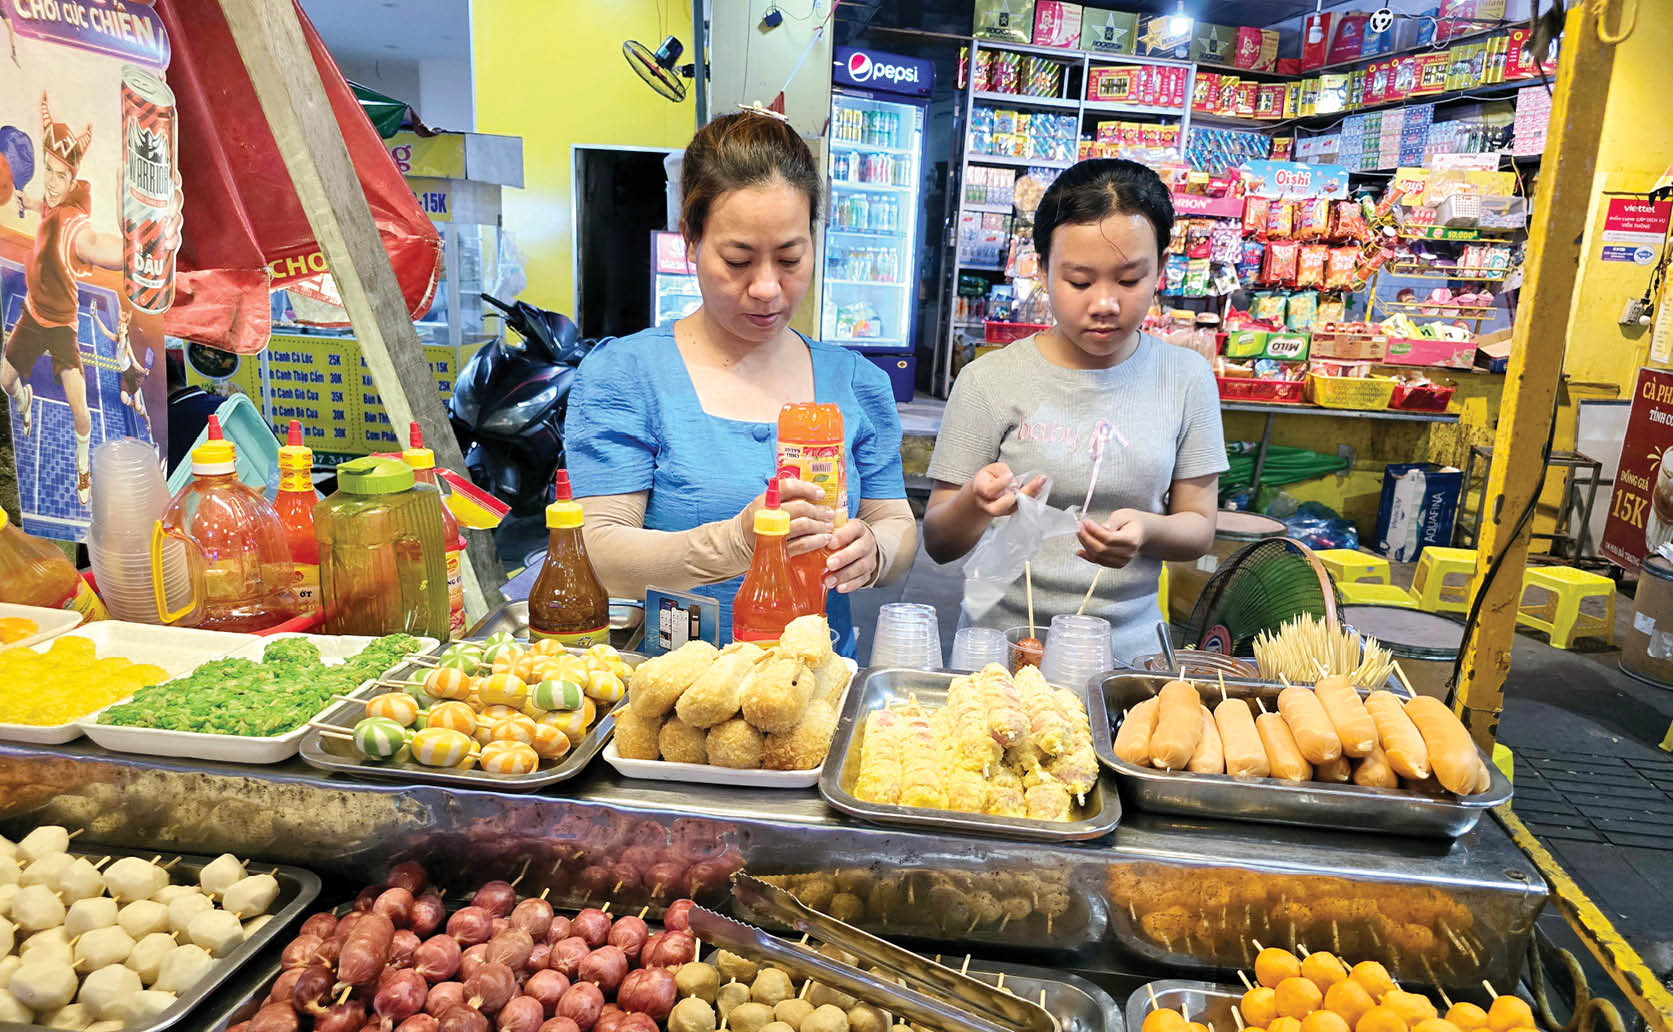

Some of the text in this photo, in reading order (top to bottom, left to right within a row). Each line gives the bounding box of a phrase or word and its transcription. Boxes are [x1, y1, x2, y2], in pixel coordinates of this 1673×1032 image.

[873, 61, 920, 83] pepsi
[1275, 169, 1311, 186] Oishi
[1623, 205, 1656, 213] viettel
[134, 252, 164, 276] DÂU
[1271, 342, 1300, 352] MILO
[1642, 376, 1656, 401] CÀ
[1017, 412, 1080, 453] baby
[1423, 490, 1446, 543] AQUAFINA
[1612, 488, 1648, 529] 15K
